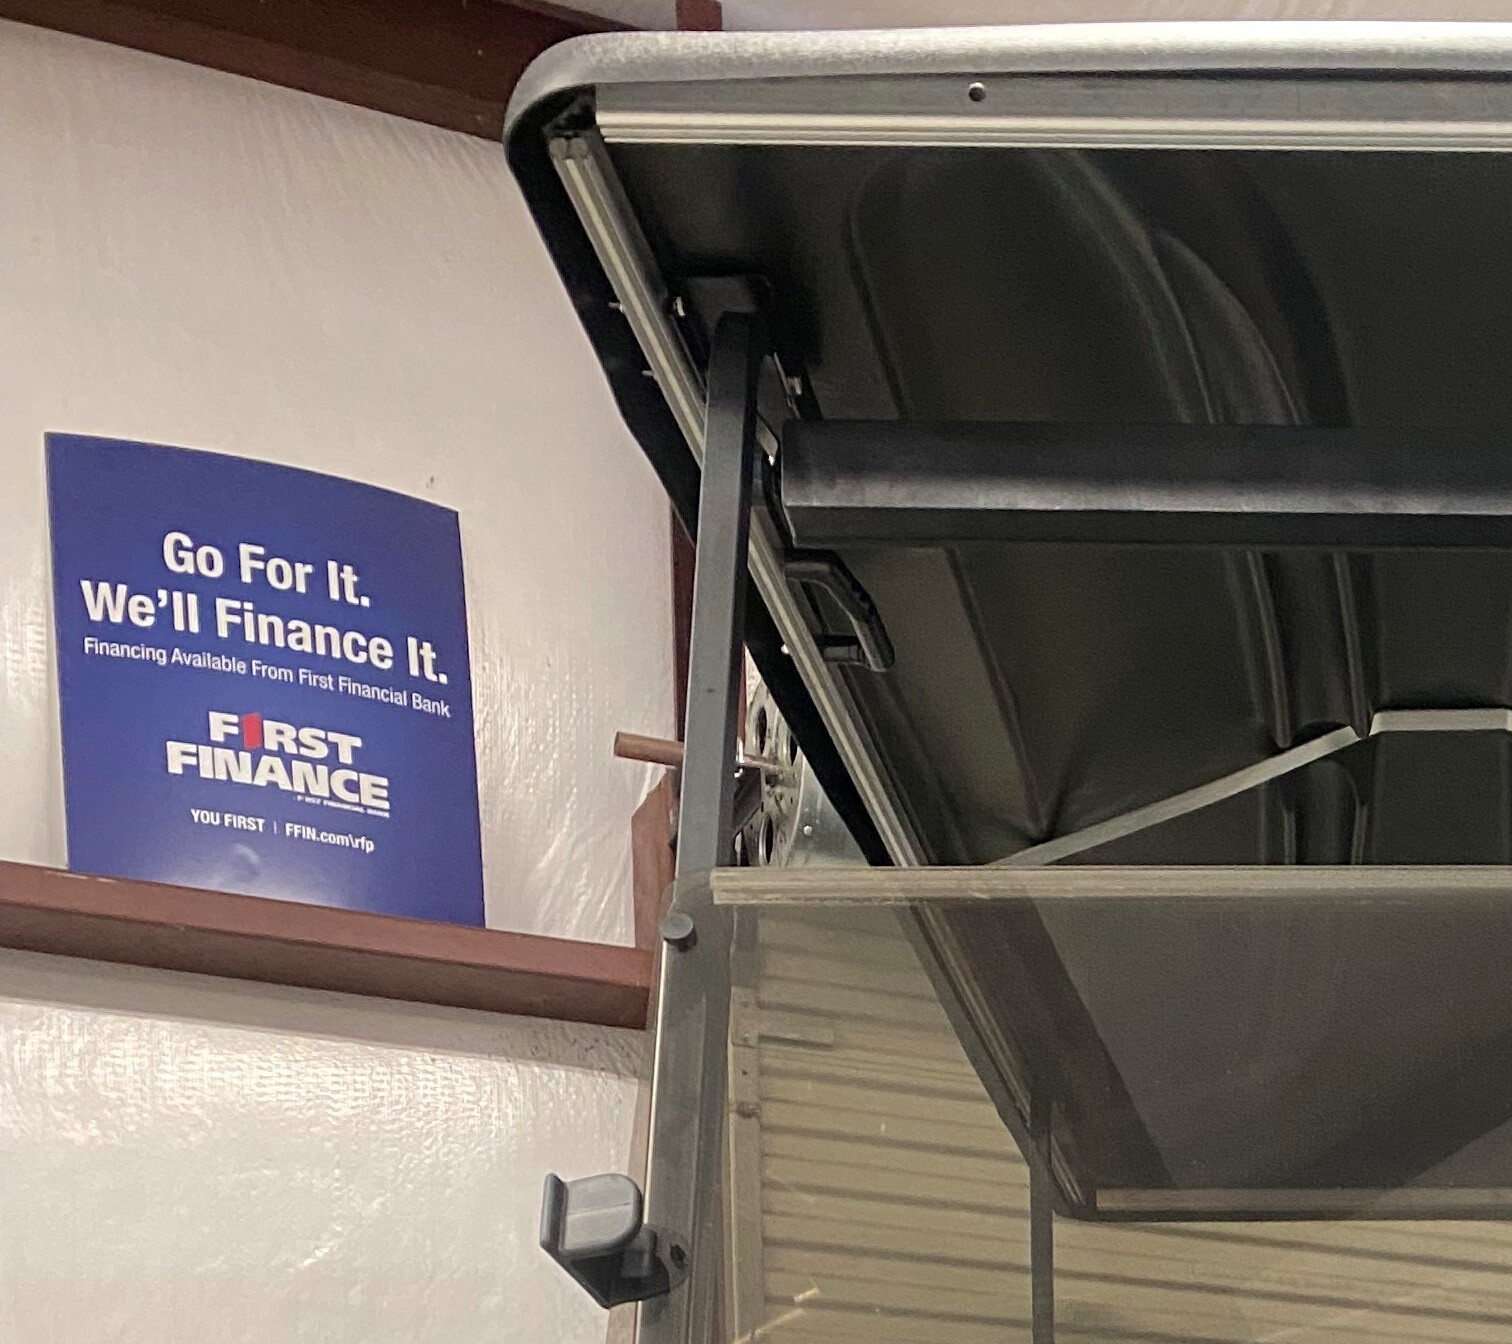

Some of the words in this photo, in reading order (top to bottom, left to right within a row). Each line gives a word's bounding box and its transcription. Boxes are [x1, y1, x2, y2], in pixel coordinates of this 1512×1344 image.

[163, 531, 224, 579] Go
[239, 542, 313, 593] For
[327, 559, 371, 608] It.
[80, 579, 200, 634] We'll
[216, 596, 394, 670] Finance
[407, 635, 449, 685] It.
[83, 636, 167, 666] Financing
[171, 647, 248, 675] Available
[252, 659, 294, 683] From
[299, 668, 334, 692] First
[339, 675, 407, 707] Financial
[412, 692, 452, 719] Bank
[166, 740, 391, 810] FINANCE
[191, 807, 220, 827] YOU
[224, 812, 265, 833] FIRST
